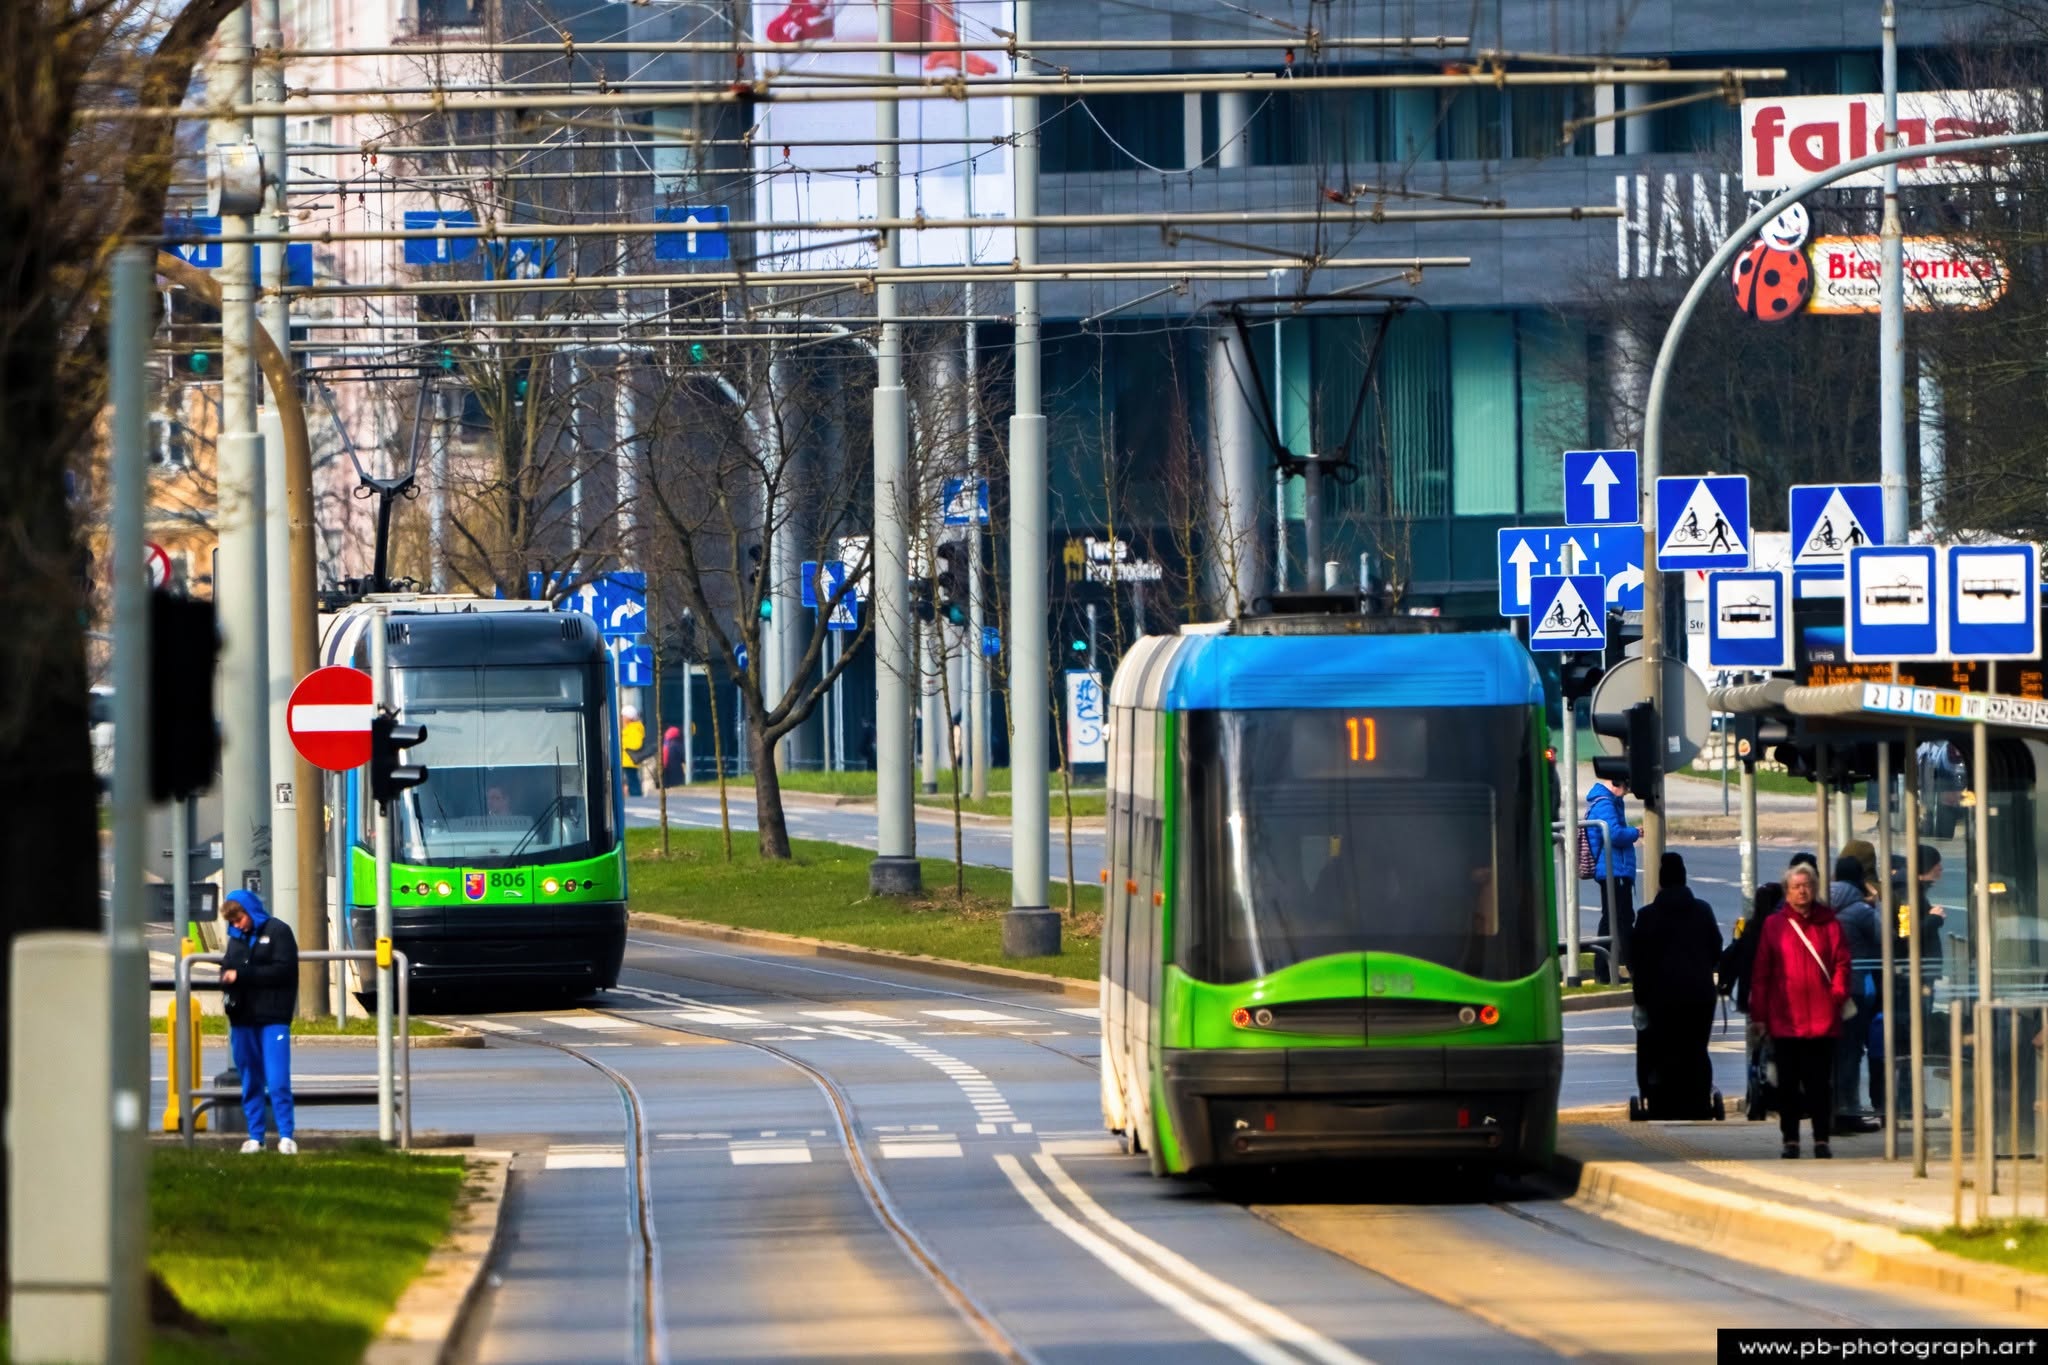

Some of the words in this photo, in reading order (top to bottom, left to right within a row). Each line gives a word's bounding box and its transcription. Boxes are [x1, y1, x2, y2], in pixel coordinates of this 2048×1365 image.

[1873, 687, 1880, 706] 2
[1898, 689, 1904, 708] 3
[1942, 697, 1956, 714] 11
[1346, 717, 1376, 761] 11
[491, 873, 526, 888] 806
